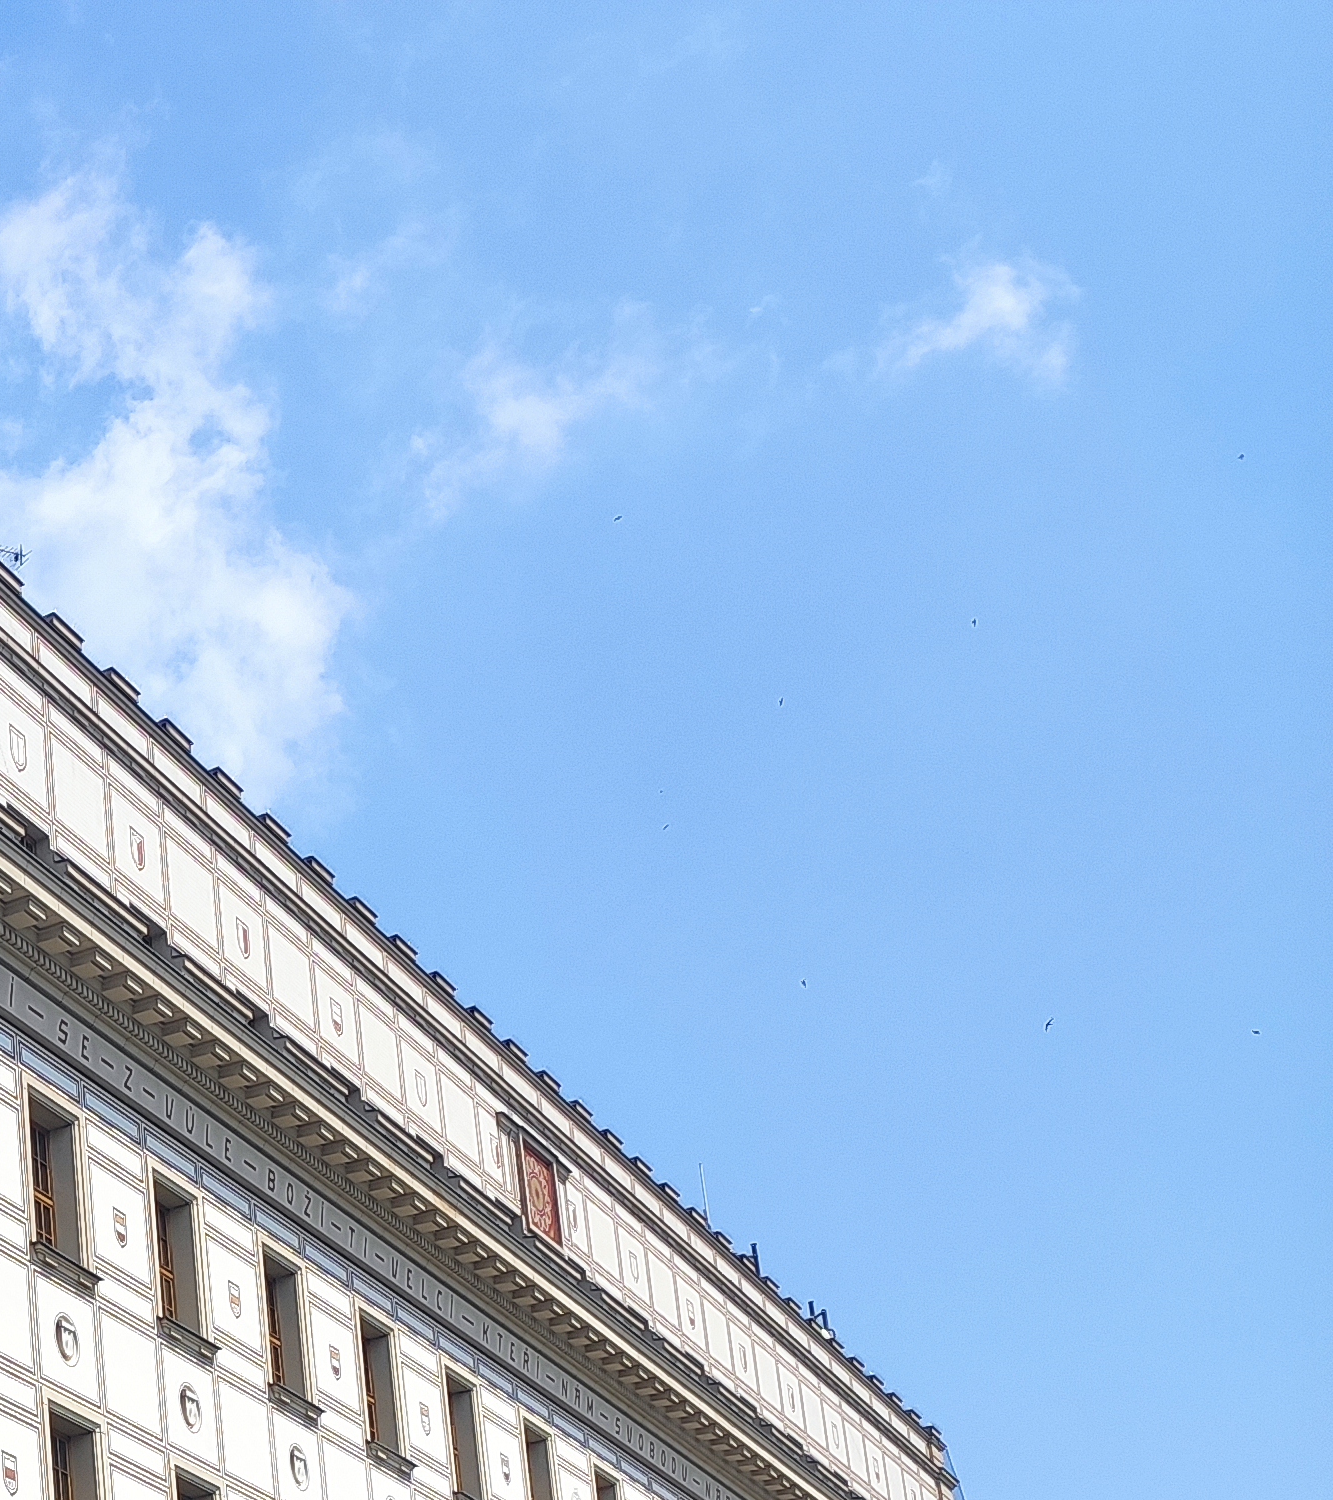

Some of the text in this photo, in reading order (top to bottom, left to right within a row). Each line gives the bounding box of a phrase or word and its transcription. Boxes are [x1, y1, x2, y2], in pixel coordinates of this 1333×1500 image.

[58, 1018, 90, 1062] SE
[124, 1065, 133, 1092] Z
[348, 1225, 367, 1258] TI
[614, 1418, 688, 1482] SVOBODU
